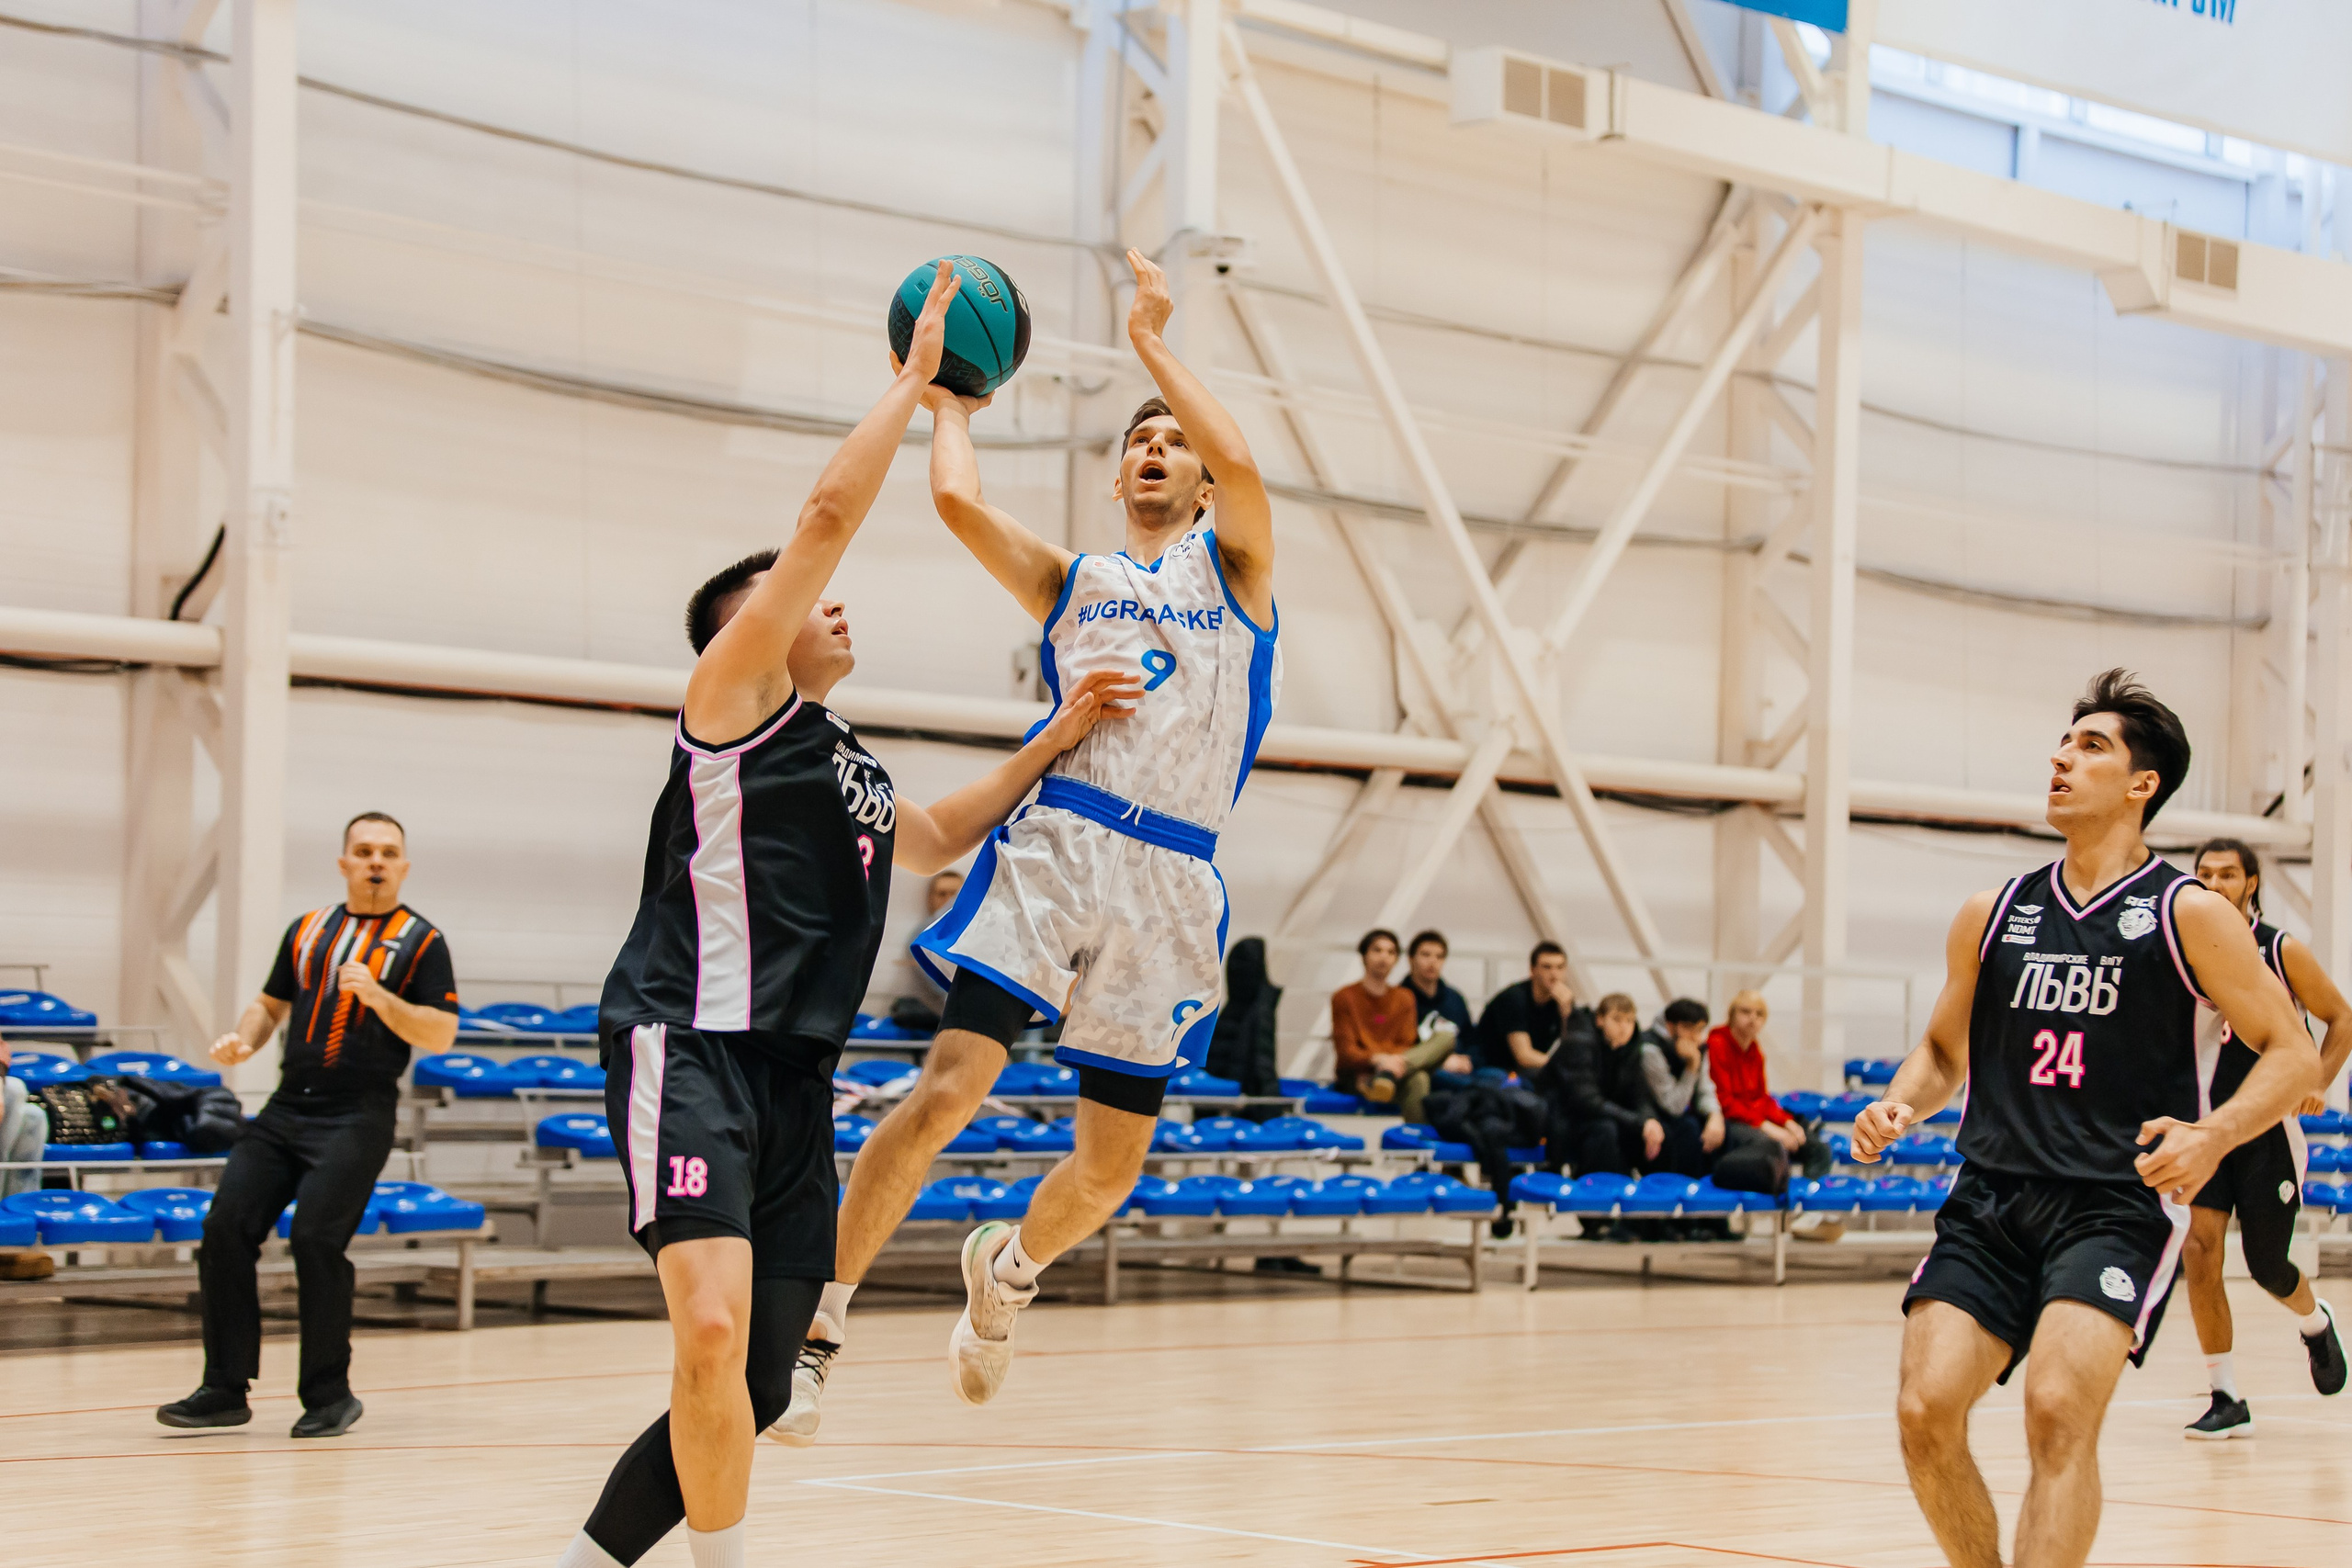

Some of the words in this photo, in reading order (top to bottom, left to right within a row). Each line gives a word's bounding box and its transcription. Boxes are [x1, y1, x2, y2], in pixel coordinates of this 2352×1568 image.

[1140, 649, 1178, 692] 9
[2009, 962, 2122, 1016] ЛЬВЫ
[2030, 1029, 2086, 1089] 24
[667, 1156, 708, 1198] 18
